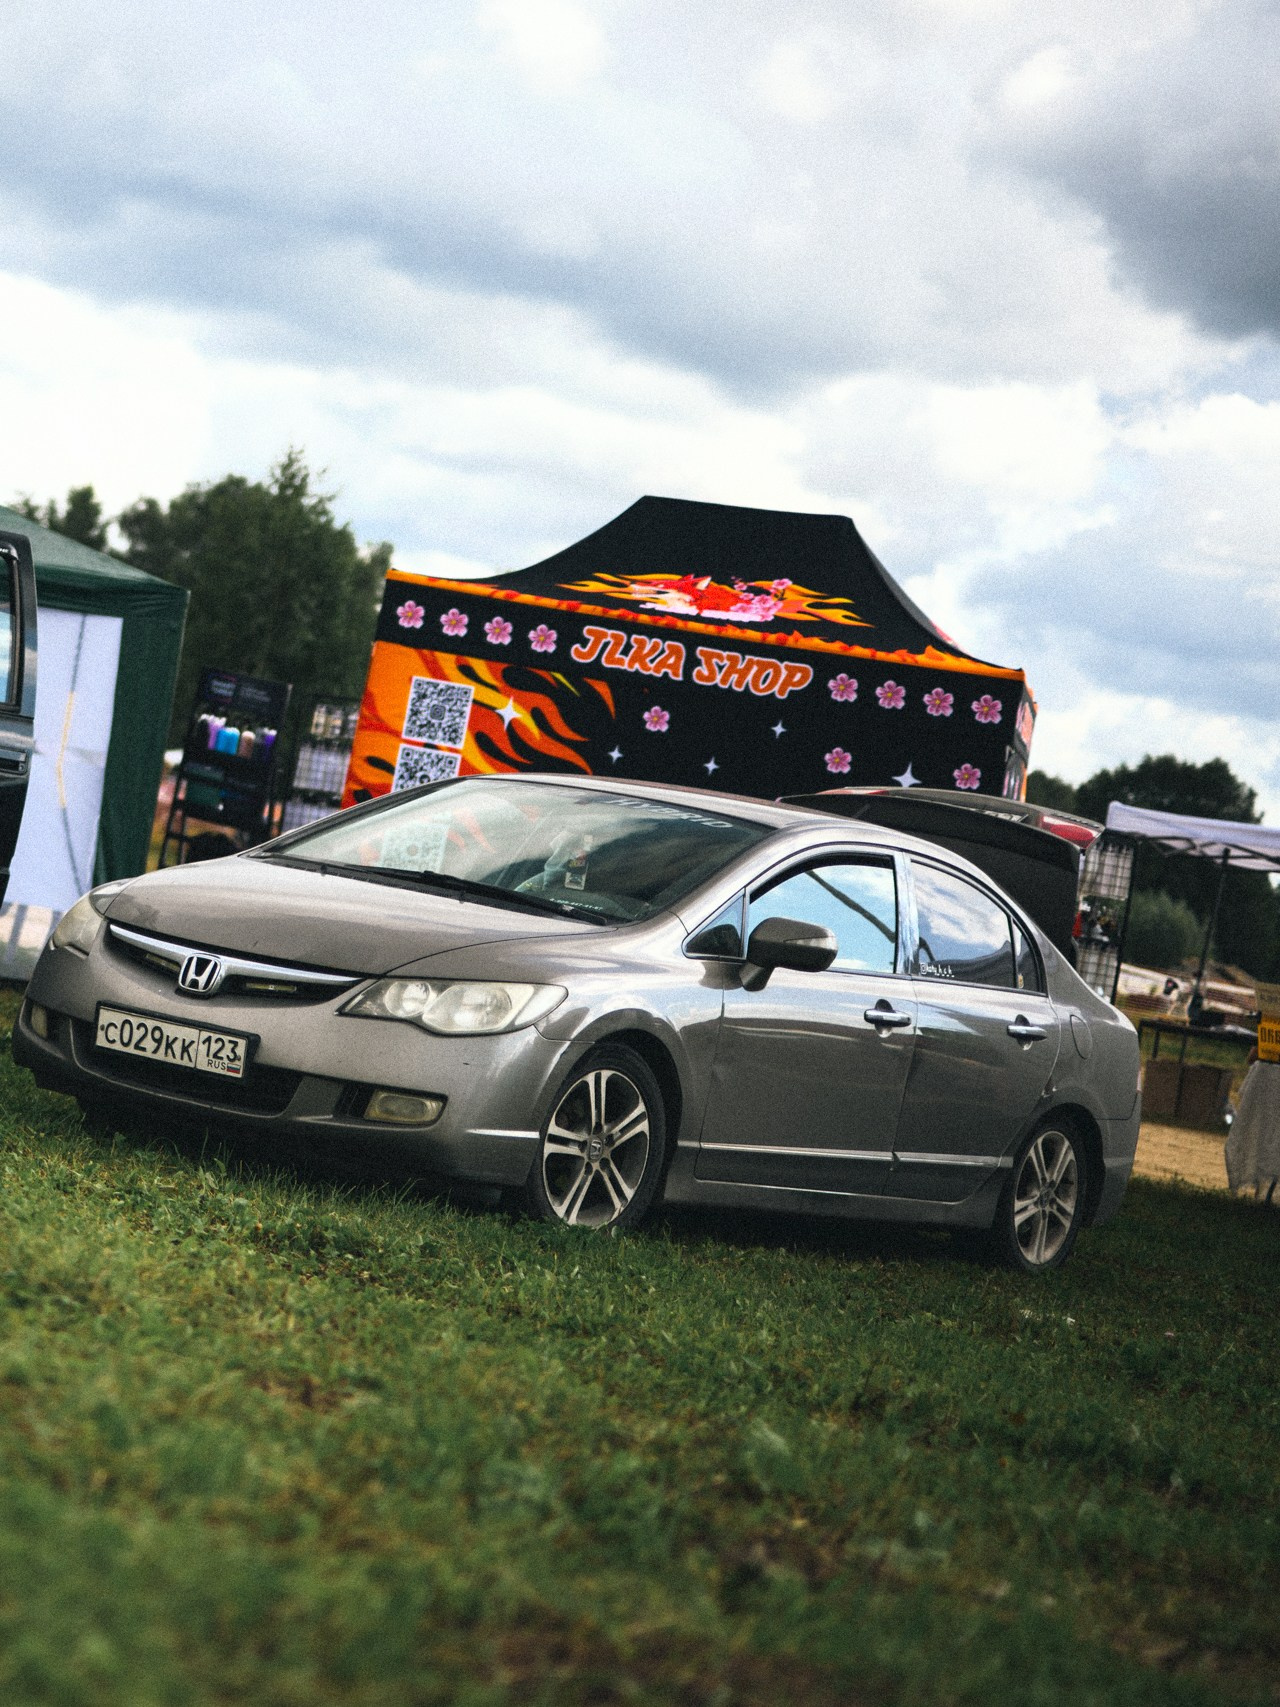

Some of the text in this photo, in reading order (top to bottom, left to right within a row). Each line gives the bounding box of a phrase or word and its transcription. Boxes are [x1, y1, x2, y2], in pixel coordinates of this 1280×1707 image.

[693, 646, 814, 700] SHOP
[605, 798, 734, 829] HYBRID
[201, 1034, 239, 1063] 123
[207, 1058, 227, 1071] RUS
